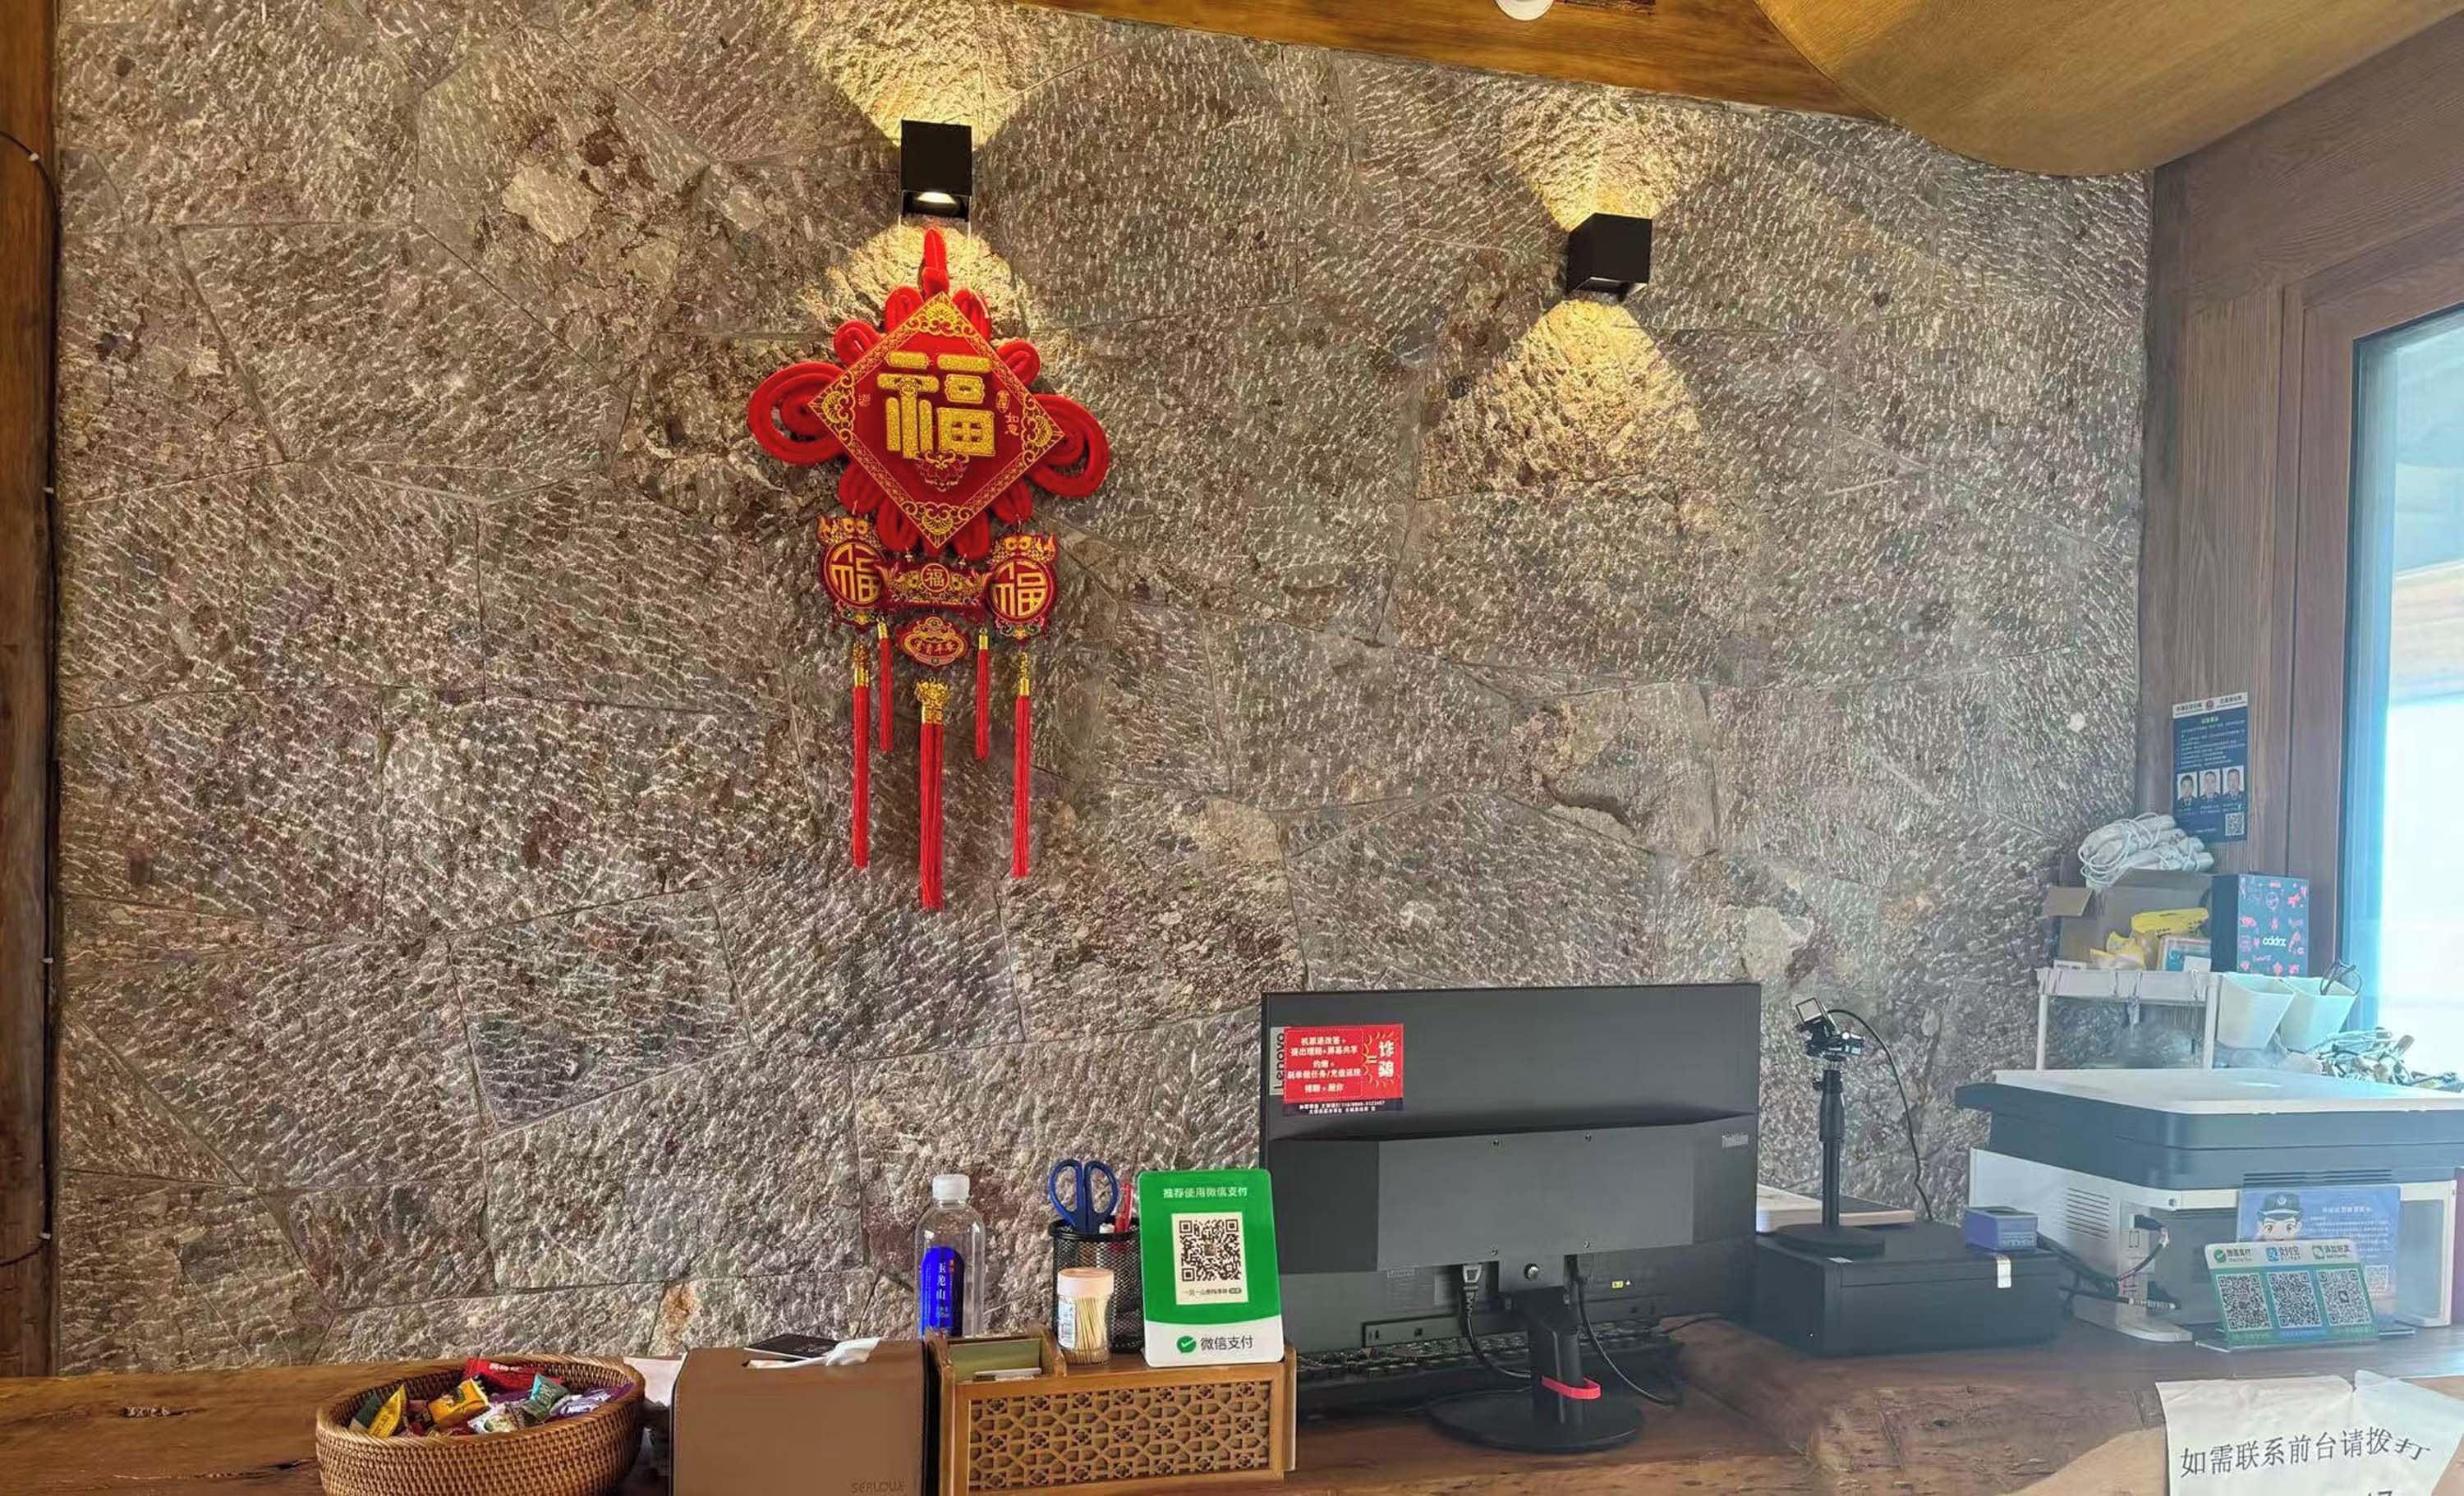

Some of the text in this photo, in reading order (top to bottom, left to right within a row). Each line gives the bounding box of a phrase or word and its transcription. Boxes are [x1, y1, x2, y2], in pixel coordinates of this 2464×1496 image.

[876, 351, 996, 461] 福
[829, 542, 884, 603] 福
[926, 568, 945, 588] 福
[991, 560, 1048, 617] 福
[1274, 1032, 1285, 1090] Lenovo
[1163, 1186, 1248, 1199] 推荐使用微信支付
[1200, 1335, 1254, 1351] 微信支付
[2180, 1425, 2431, 1479] 如需联系前台请拨打
